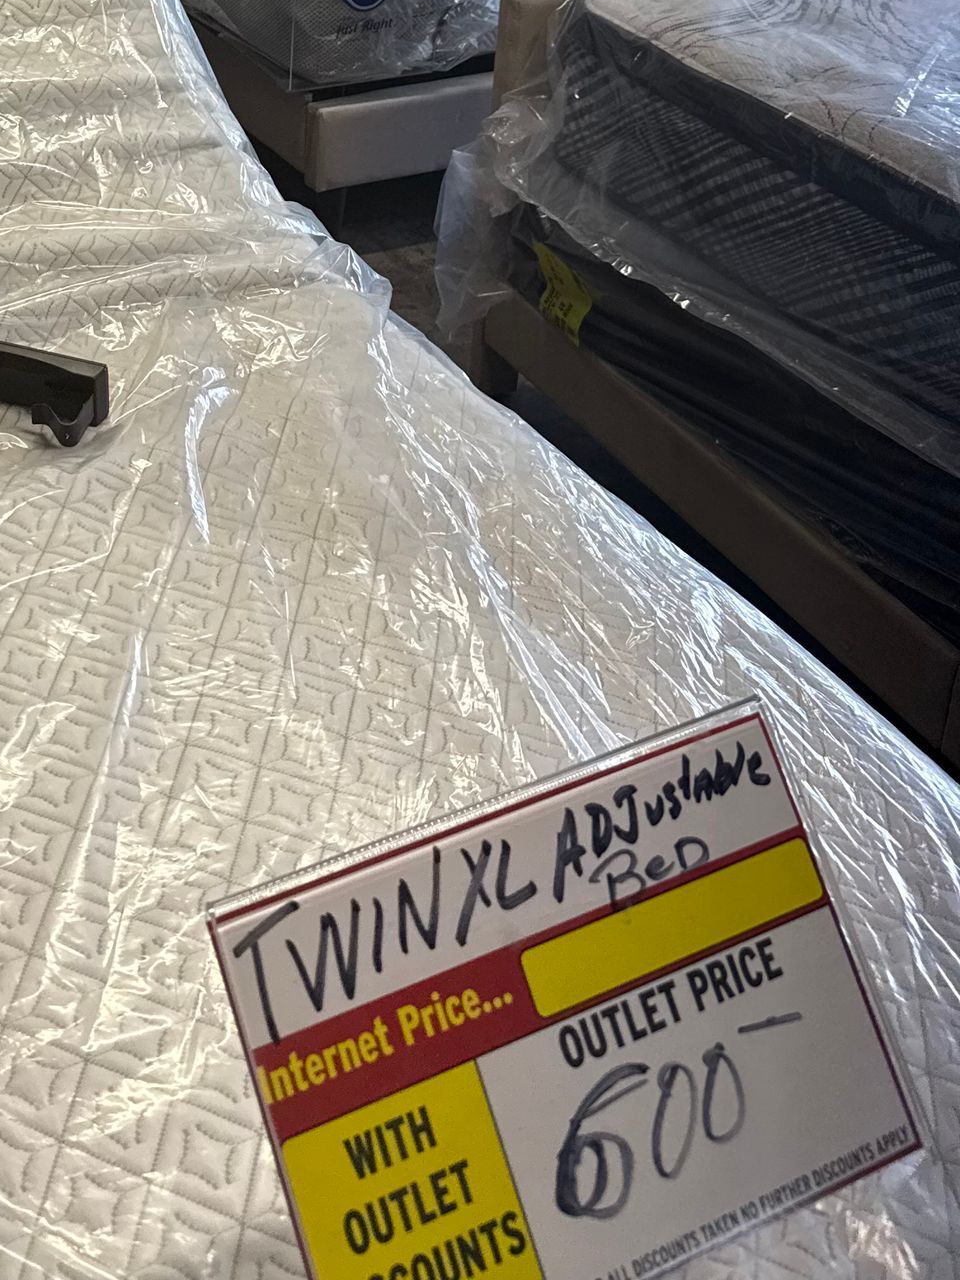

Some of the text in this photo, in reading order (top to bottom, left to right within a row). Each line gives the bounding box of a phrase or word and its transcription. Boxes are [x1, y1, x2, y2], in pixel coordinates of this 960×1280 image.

[233, 845, 441, 1046] TWIN
[456, 839, 538, 947] XL
[256, 987, 513, 1105] Internet Price...
[558, 937, 784, 1068] OUTLET PRICE
[342, 1105, 437, 1180] WITH
[631, 1230, 701, 1277] DISCOUNTS
[699, 1209, 740, 1242] TAKEN
[739, 1200, 760, 1219] NO
[758, 1173, 815, 1214] FURTHER
[812, 1143, 876, 1187] DISCOUNTS
[875, 1124, 910, 1156] APPLY
[342, 1158, 474, 1255] OUTLET
[367, 1210, 526, 1280] OUNTS
